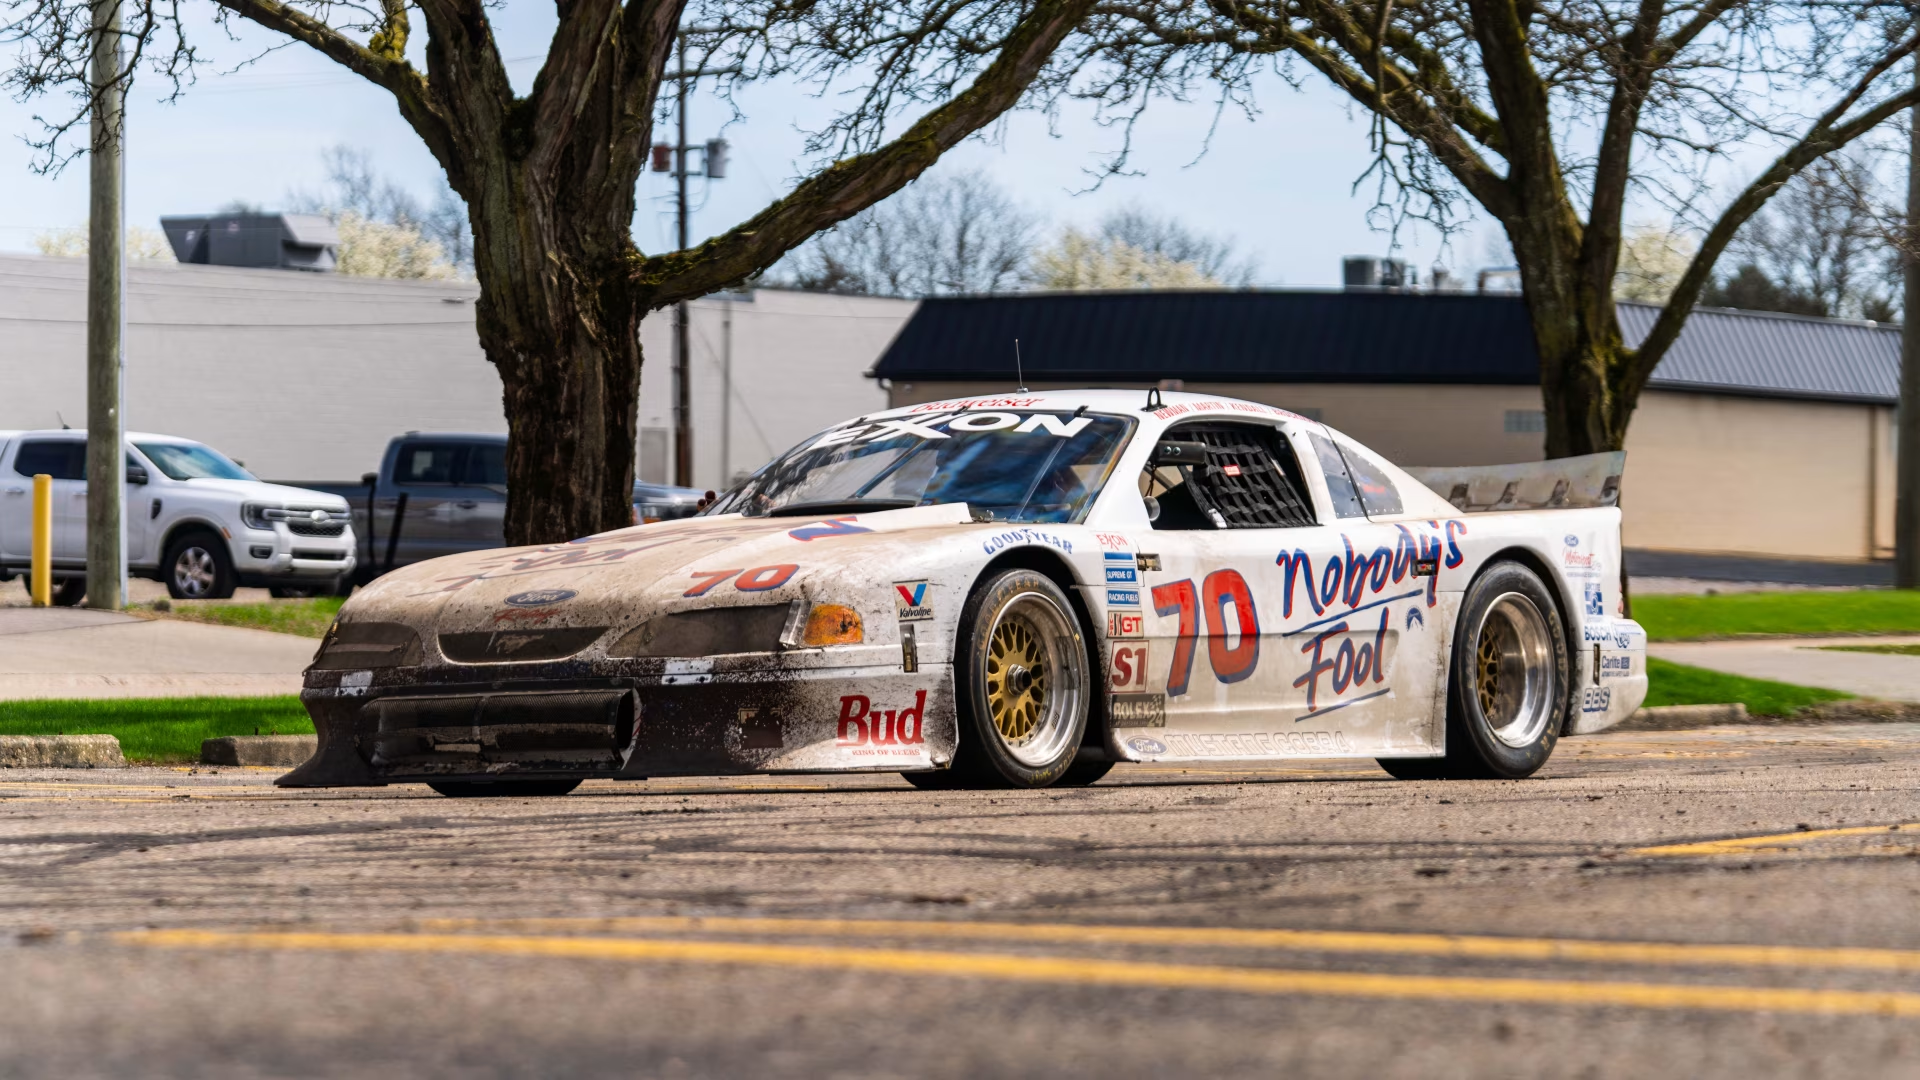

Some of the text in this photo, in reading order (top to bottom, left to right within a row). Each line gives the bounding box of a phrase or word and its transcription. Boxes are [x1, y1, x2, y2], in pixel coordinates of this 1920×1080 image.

[907, 398, 1046, 413] Budweiser
[1153, 403, 1190, 421] NEWMAN
[1192, 401, 1225, 412] MARTIN
[807, 411, 1094, 450] EXXON
[1096, 533, 1128, 550] EXXON
[683, 563, 800, 597] 70
[1107, 570, 1133, 579] SUPREME GT
[1276, 519, 1468, 620] Nobody's
[1108, 592, 1139, 602] RACING FUELS
[899, 607, 932, 618] Valvoline
[1121, 616, 1143, 633] GT
[1151, 568, 1260, 697] 70
[1111, 647, 1147, 687] S1
[1293, 606, 1390, 712] Fool
[1582, 686, 1611, 712] BBS
[836, 689, 928, 748] Bud
[1113, 701, 1164, 728] ROLEX 24
[1131, 736, 1163, 753] Ford
